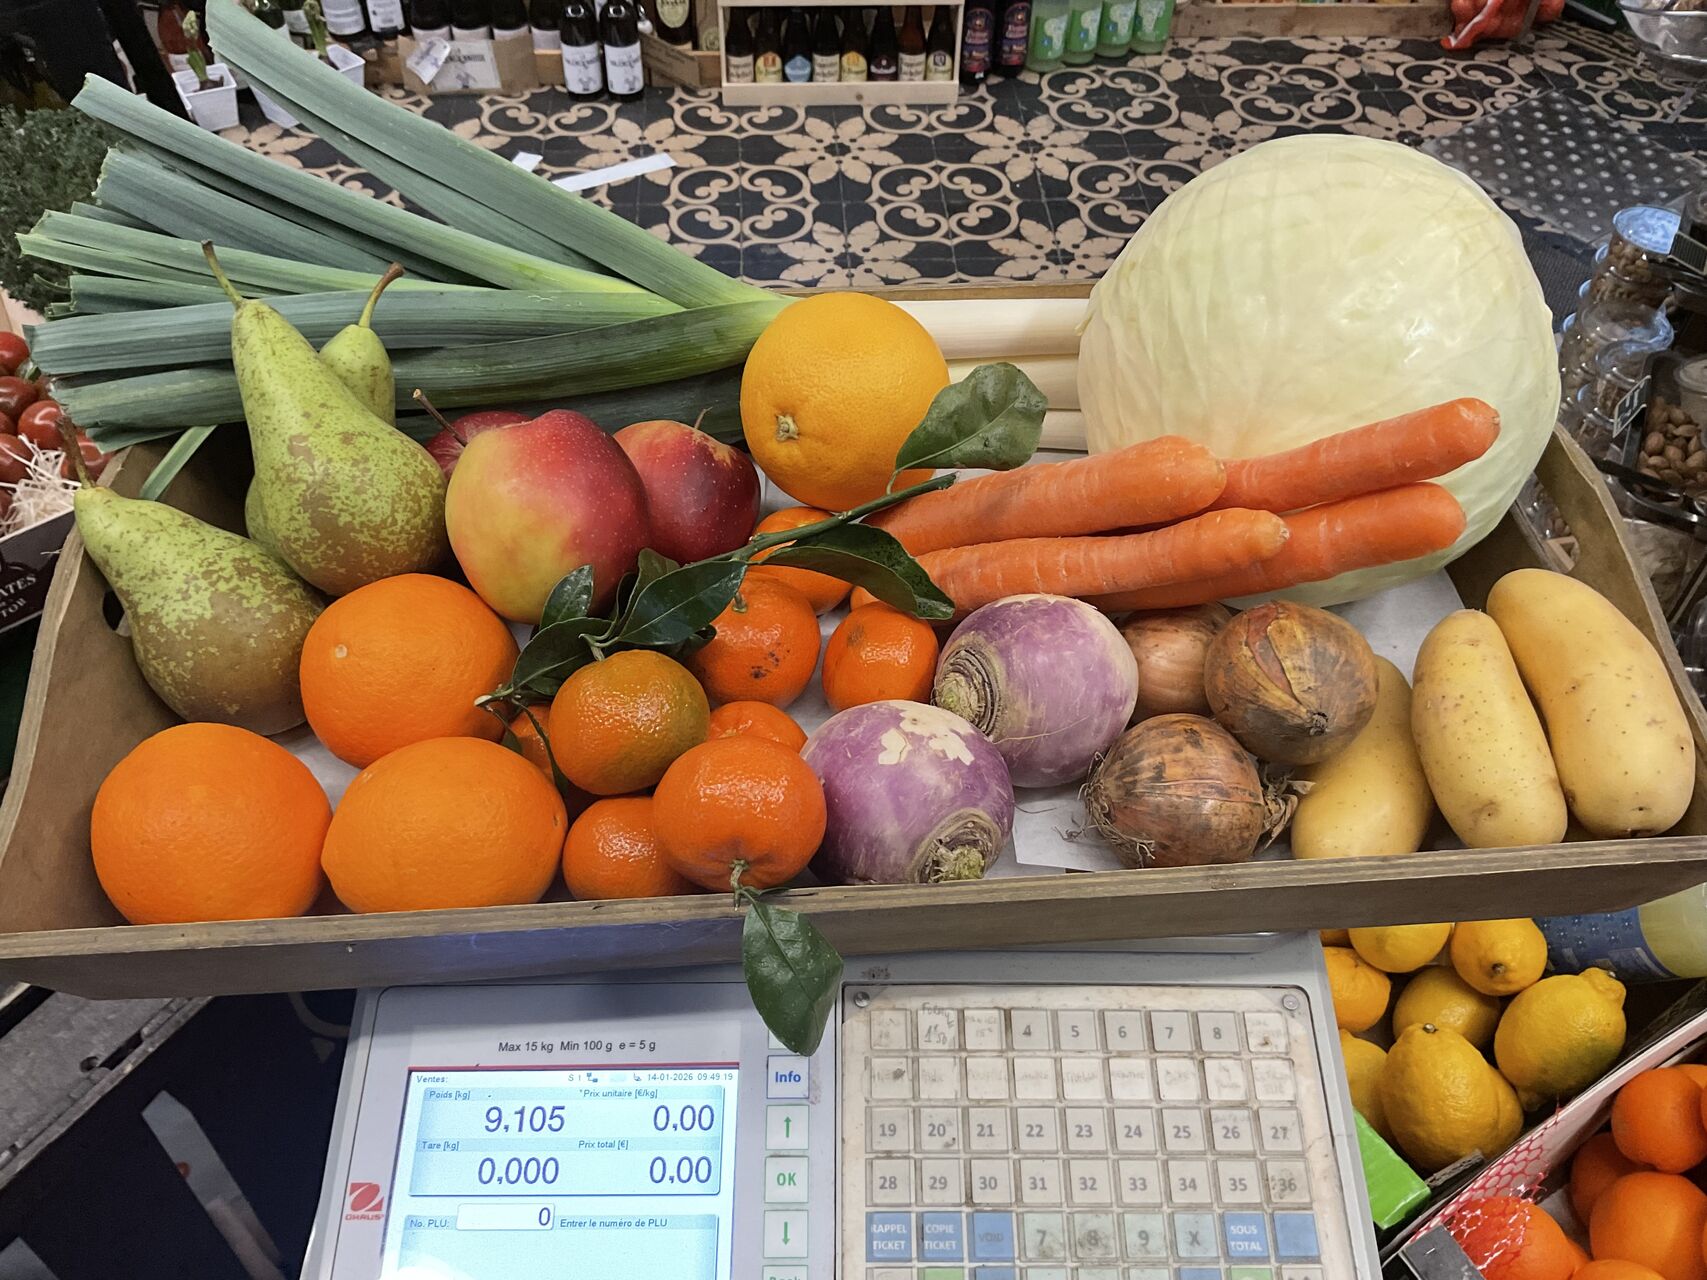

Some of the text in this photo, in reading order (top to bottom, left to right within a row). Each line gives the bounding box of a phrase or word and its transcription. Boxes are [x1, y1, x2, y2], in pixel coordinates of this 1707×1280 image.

[1022, 1025, 1032, 1036] 4
[1071, 1026, 1080, 1038] 5
[1118, 1026, 1128, 1039] 6
[1165, 1027, 1174, 1040] 7
[1212, 1027, 1223, 1040] 8
[498, 1042, 521, 1052] Max
[525, 1041, 538, 1051] 15
[541, 1041, 554, 1053] kg
[560, 1041, 579, 1051] Min
[583, 1040, 602, 1051] 100
[605, 1042, 613, 1053] g
[619, 1042, 626, 1050] e
[639, 1040, 646, 1050] 5
[649, 1041, 656, 1052] g
[416, 1075, 448, 1083] Ventes:
[647, 1073, 693, 1081] 14-01-2026
[775, 1071, 801, 1083] Info
[429, 1090, 471, 1100] Poids [kg]
[602, 1089, 632, 1097] unitaire
[634, 1089, 658, 1099] [€/kg]
[484, 1105, 565, 1133] 9,105
[653, 1104, 715, 1131] 0,00
[879, 1123, 897, 1137] 19
[928, 1123, 946, 1137] 20
[976, 1123, 995, 1137] 21
[1025, 1124, 1044, 1138] 22
[1075, 1124, 1093, 1138] 23
[1124, 1125, 1143, 1139] 24
[1173, 1125, 1191, 1139] 25
[1222, 1126, 1240, 1140] 26
[1271, 1126, 1288, 1140] 27
[422, 1141, 459, 1151] Tare [kg]
[578, 1140, 629, 1149] Prix total [€]
[478, 1157, 560, 1185] 0,000
[649, 1156, 712, 1184] 0,00
[777, 1172, 797, 1186] OK
[879, 1176, 898, 1190] 28
[929, 1176, 948, 1190] 29
[979, 1176, 998, 1190] 30
[1029, 1176, 1047, 1191] 31
[1079, 1176, 1097, 1191] 32
[1129, 1177, 1147, 1191] 33
[1178, 1177, 1198, 1191] 34
[1229, 1177, 1248, 1192] 35
[1279, 1178, 1297, 1192] 36
[409, 1219, 450, 1228] No. PLU:
[538, 1207, 551, 1226] 0
[560, 1218, 668, 1228] Entrer le numéro de PLU
[871, 1224, 907, 1234] RAPPEL
[925, 1224, 954, 1234] COPIE
[1230, 1225, 1258, 1235] SOUS
[978, 1232, 1004, 1242] VOID
[1036, 1229, 1047, 1246] 7
[1087, 1229, 1099, 1246] 8
[1138, 1230, 1149, 1247] 9
[873, 1240, 905, 1250] TICKET
[924, 1240, 956, 1250] TICKET
[1230, 1241, 1263, 1251] TOTAL
